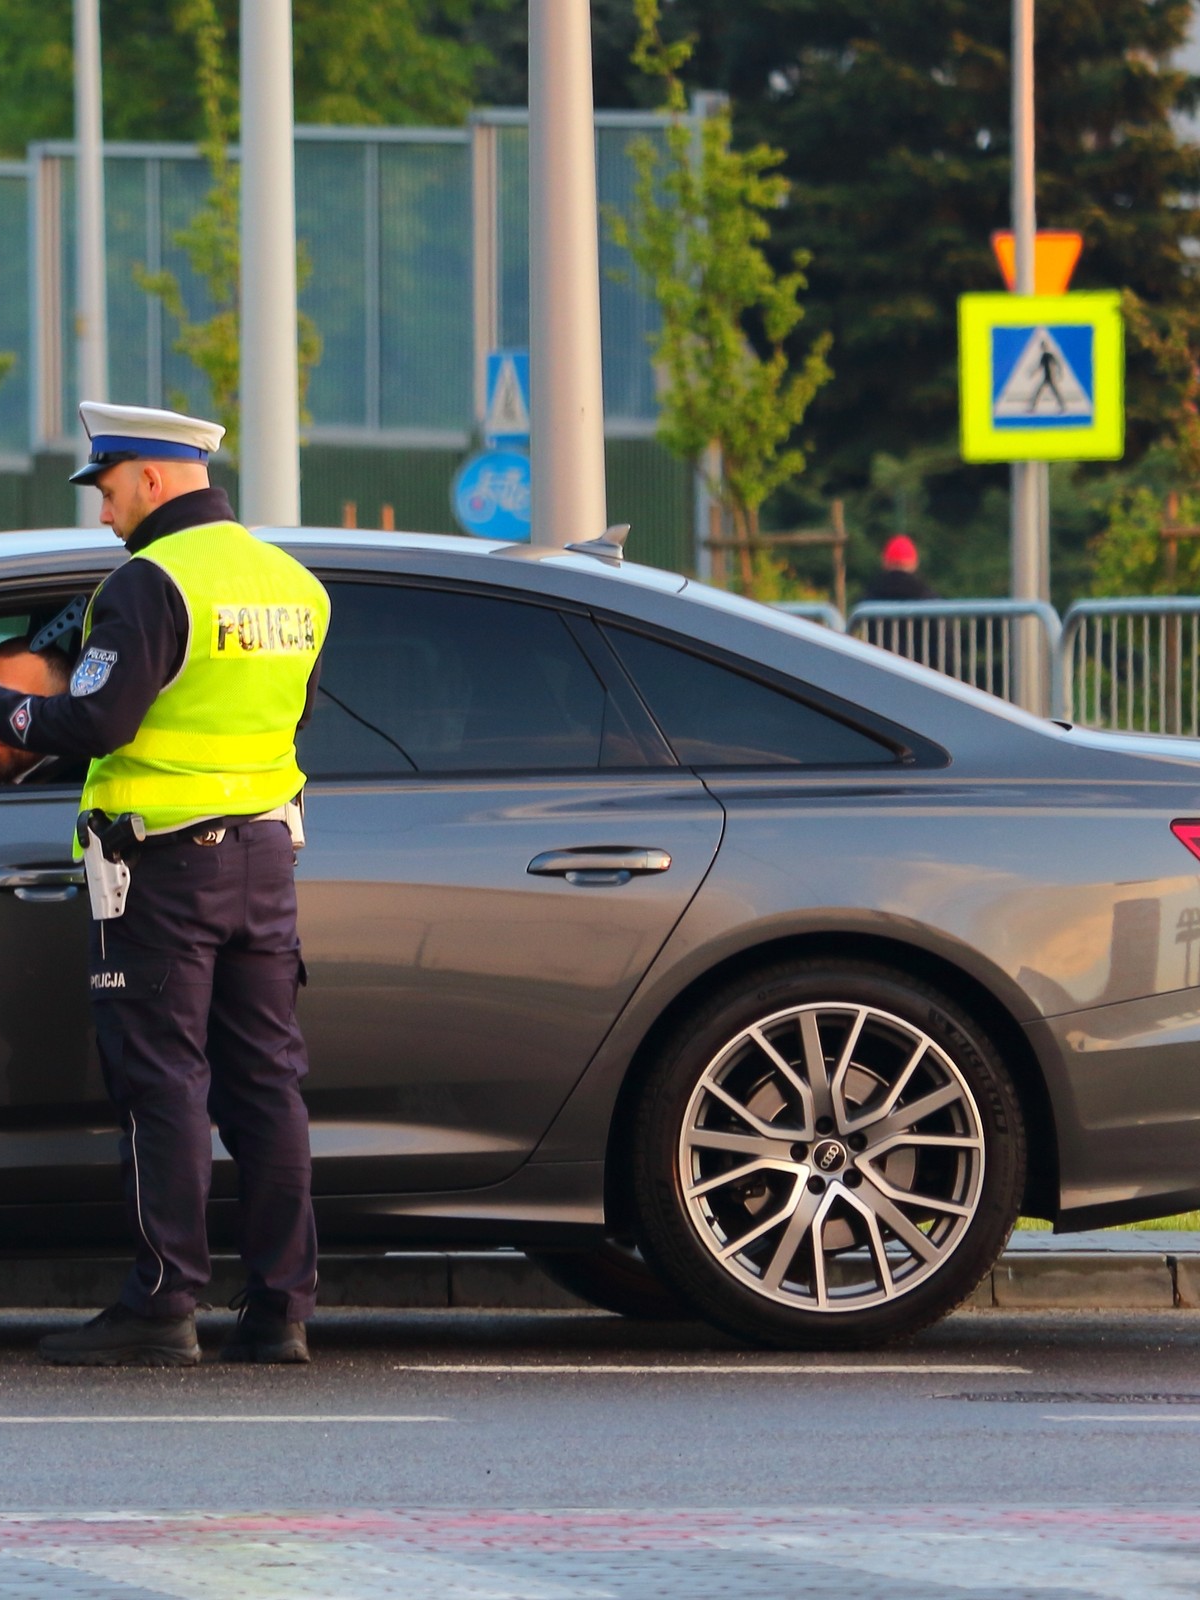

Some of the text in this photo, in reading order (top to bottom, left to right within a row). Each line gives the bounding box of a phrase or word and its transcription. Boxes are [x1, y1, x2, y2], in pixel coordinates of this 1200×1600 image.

[217, 607, 315, 651] POLICJA
[87, 650, 115, 661] POLICJA
[90, 972, 126, 989] POLICJA
